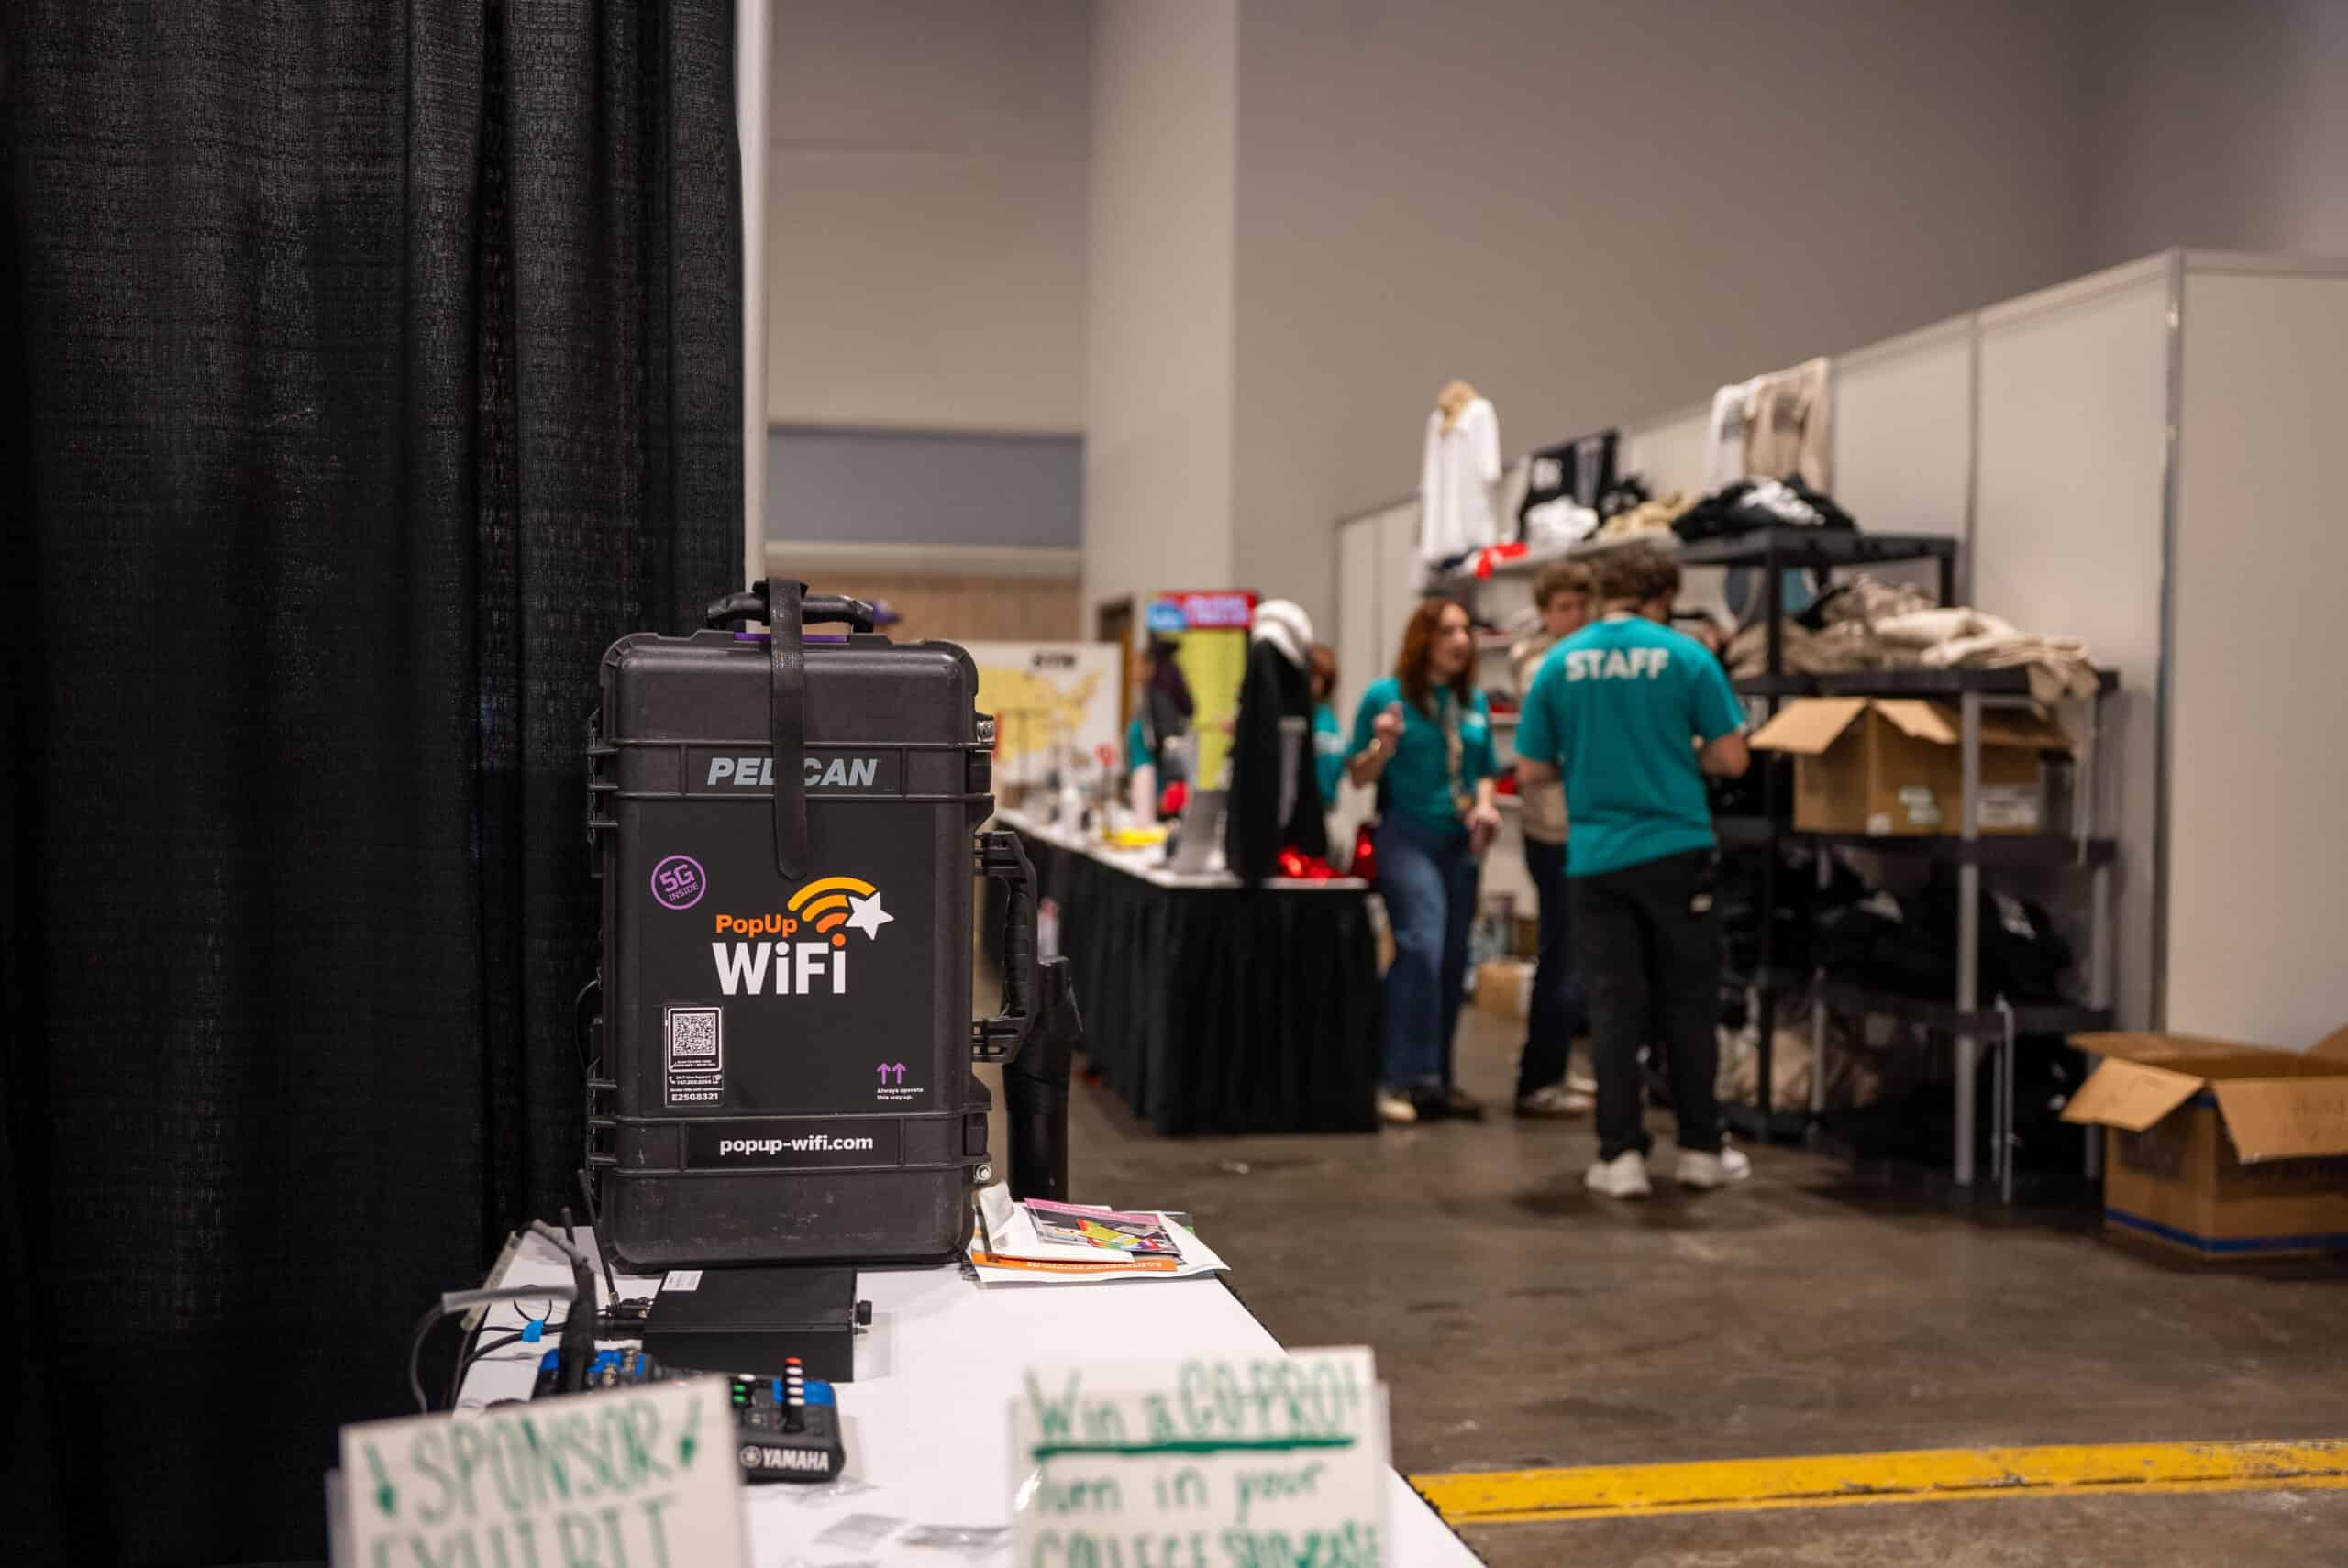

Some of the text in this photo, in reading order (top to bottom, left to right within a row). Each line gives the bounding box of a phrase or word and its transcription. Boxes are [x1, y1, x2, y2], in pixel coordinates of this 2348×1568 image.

[1565, 647, 1669, 681] STAFF
[707, 757, 879, 786] PELCAN
[659, 864, 696, 892] 5G
[669, 881, 699, 901] INSIDE
[715, 914, 798, 938] PopUp
[712, 933, 846, 996] WiFi
[719, 1134, 874, 1156] popup-wifi.com
[410, 1399, 675, 1524] SPONSOR
[761, 1448, 830, 1472] YAMAHA
[1150, 1466, 1210, 1512] in
[1233, 1461, 1330, 1526] your
